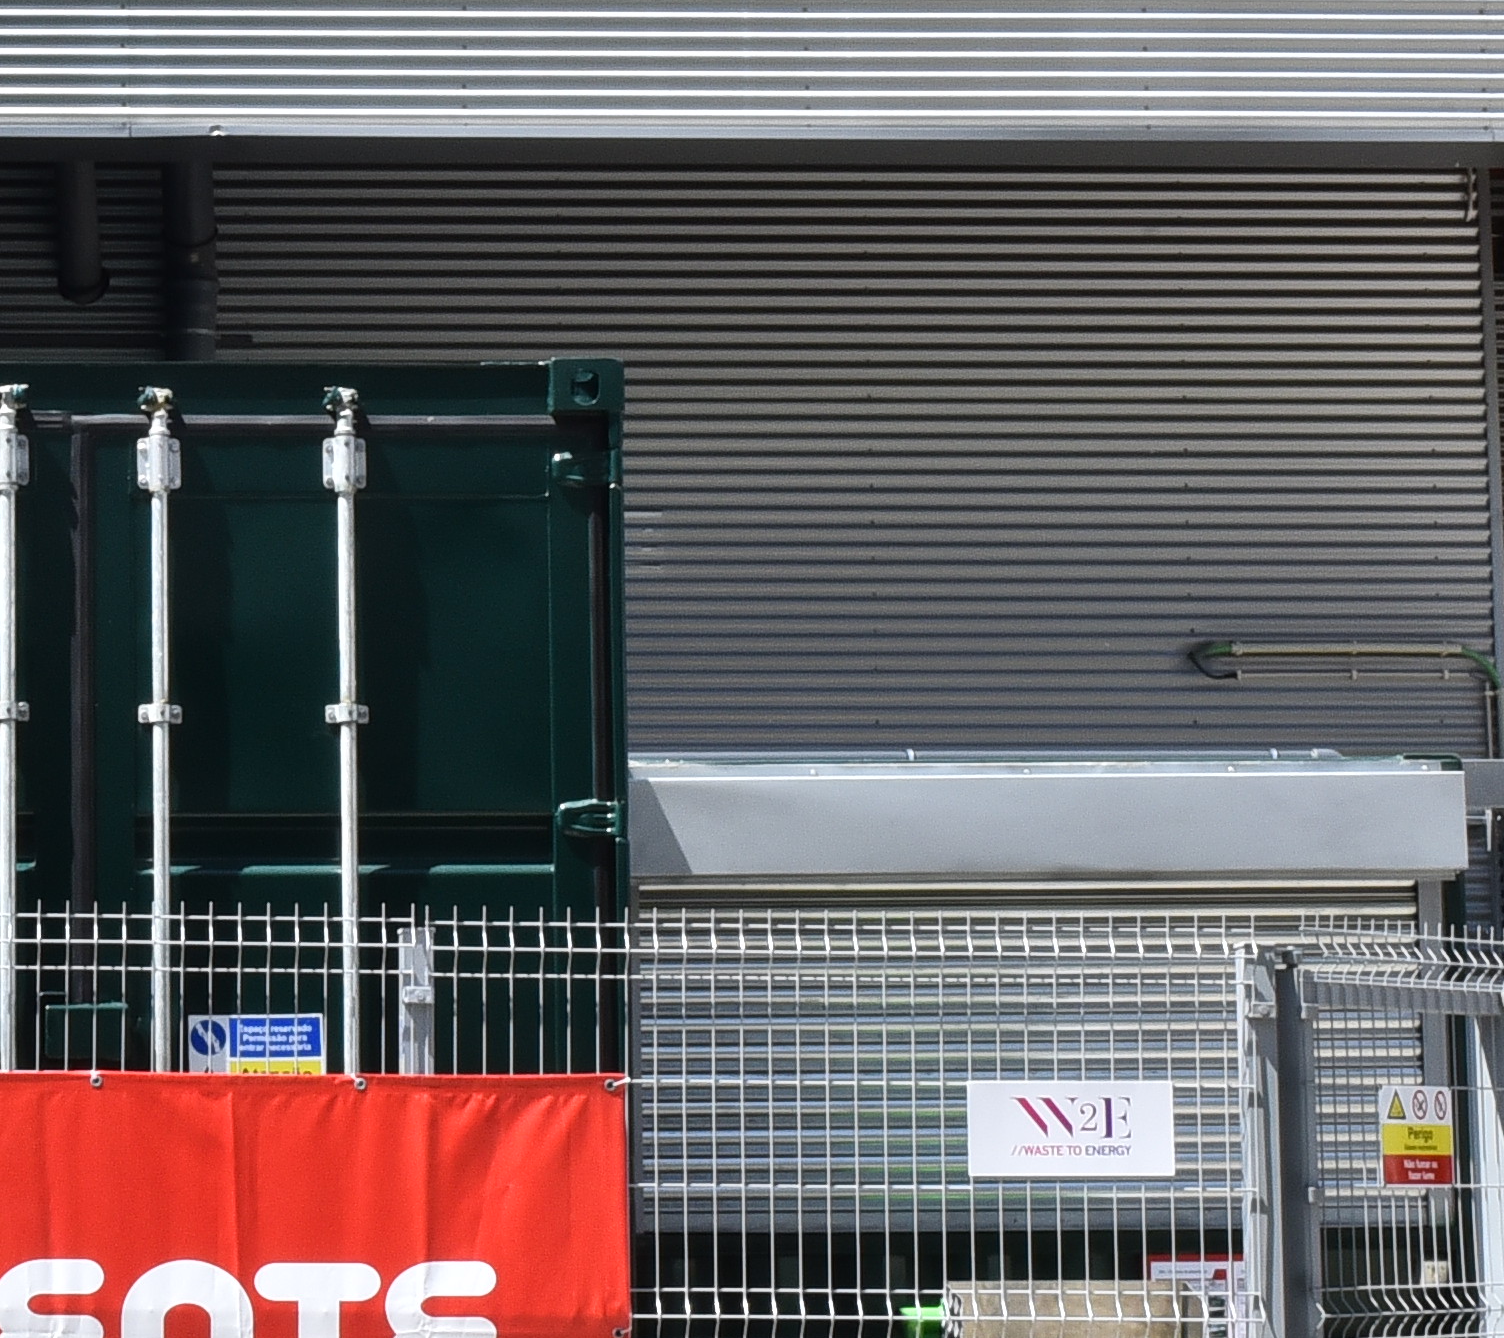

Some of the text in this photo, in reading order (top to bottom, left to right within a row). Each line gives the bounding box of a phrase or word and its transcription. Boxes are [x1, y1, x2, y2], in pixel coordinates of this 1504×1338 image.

[1009, 1096, 1132, 1139] W2E
[1066, 1145, 1083, 1157] TO
[1084, 1145, 1132, 1157] ENERGY
